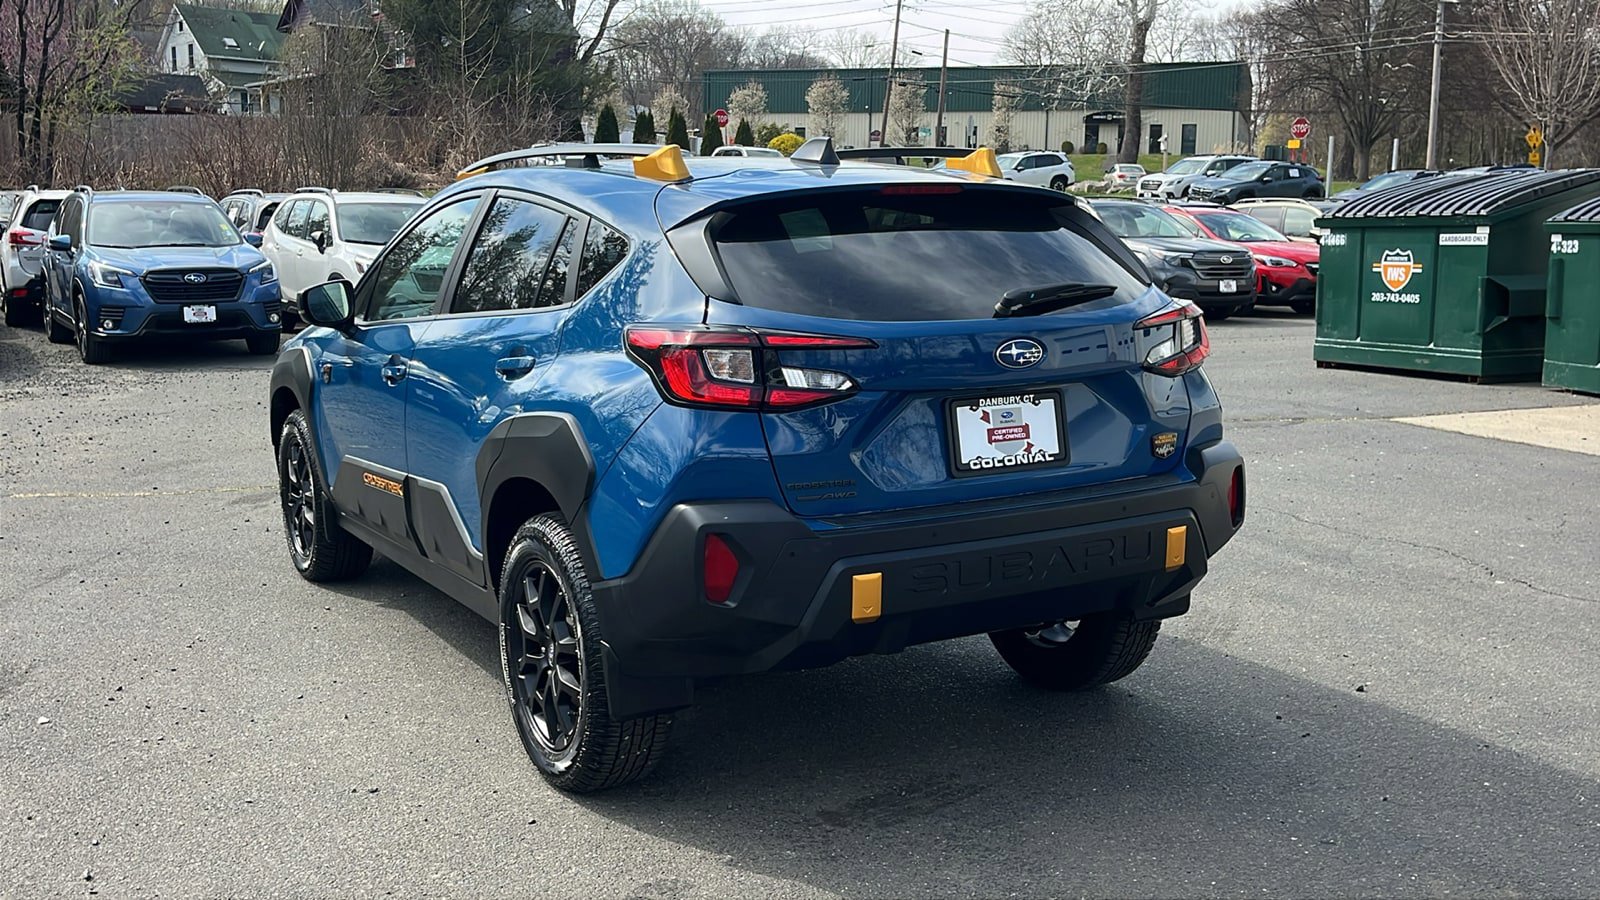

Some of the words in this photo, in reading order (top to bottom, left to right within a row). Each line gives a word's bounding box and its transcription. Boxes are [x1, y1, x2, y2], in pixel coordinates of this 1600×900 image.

[1292, 124, 1309, 133] STOP
[1441, 235, 1472, 243] CARDBOARD
[1387, 267, 1406, 282] IWS
[1371, 292, 1420, 304] 203-743-0405
[979, 395, 1021, 407] DANBURY
[1023, 394, 1035, 403] CT
[994, 427, 1023, 435] CERTIFIED
[991, 433, 1026, 441] PRE-OWNED
[969, 452, 1055, 470] COLONIAL
[821, 491, 857, 500] AWD
[908, 531, 1152, 595] SUBARU
